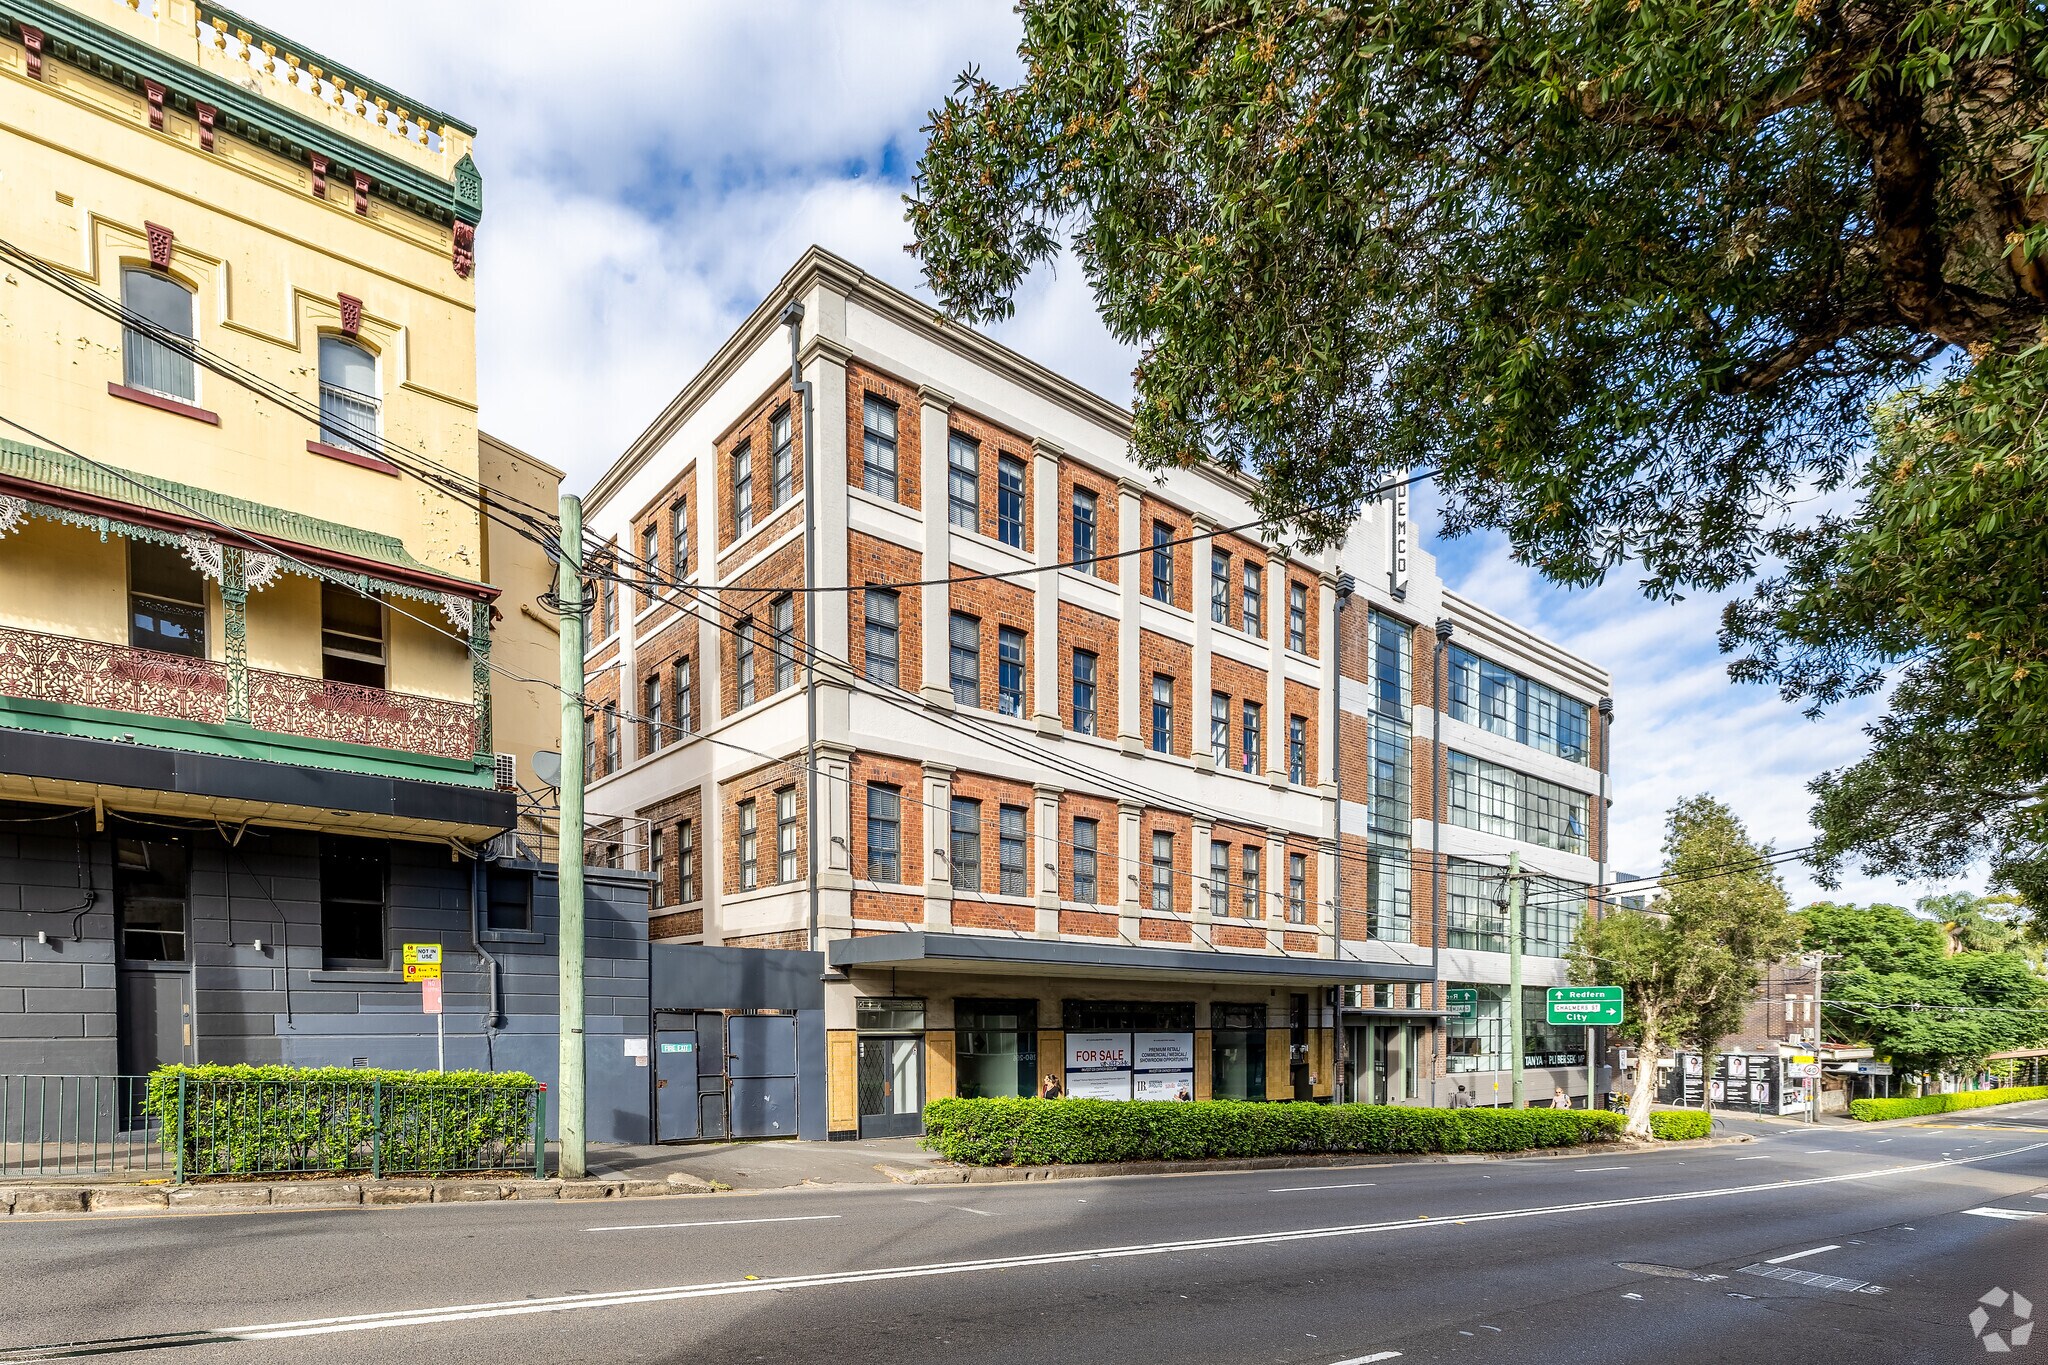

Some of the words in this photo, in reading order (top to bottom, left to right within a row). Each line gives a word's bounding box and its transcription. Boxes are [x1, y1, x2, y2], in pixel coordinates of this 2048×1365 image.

[1566, 1013, 1587, 1022] City
[678, 1044, 688, 1052] EXIT
[1076, 1050, 1097, 1062] FOR
[1099, 1049, 1124, 1061] SALE
[1525, 1055, 1543, 1066] TANYA
[1548, 1054, 1576, 1065] PLIBERSEK
